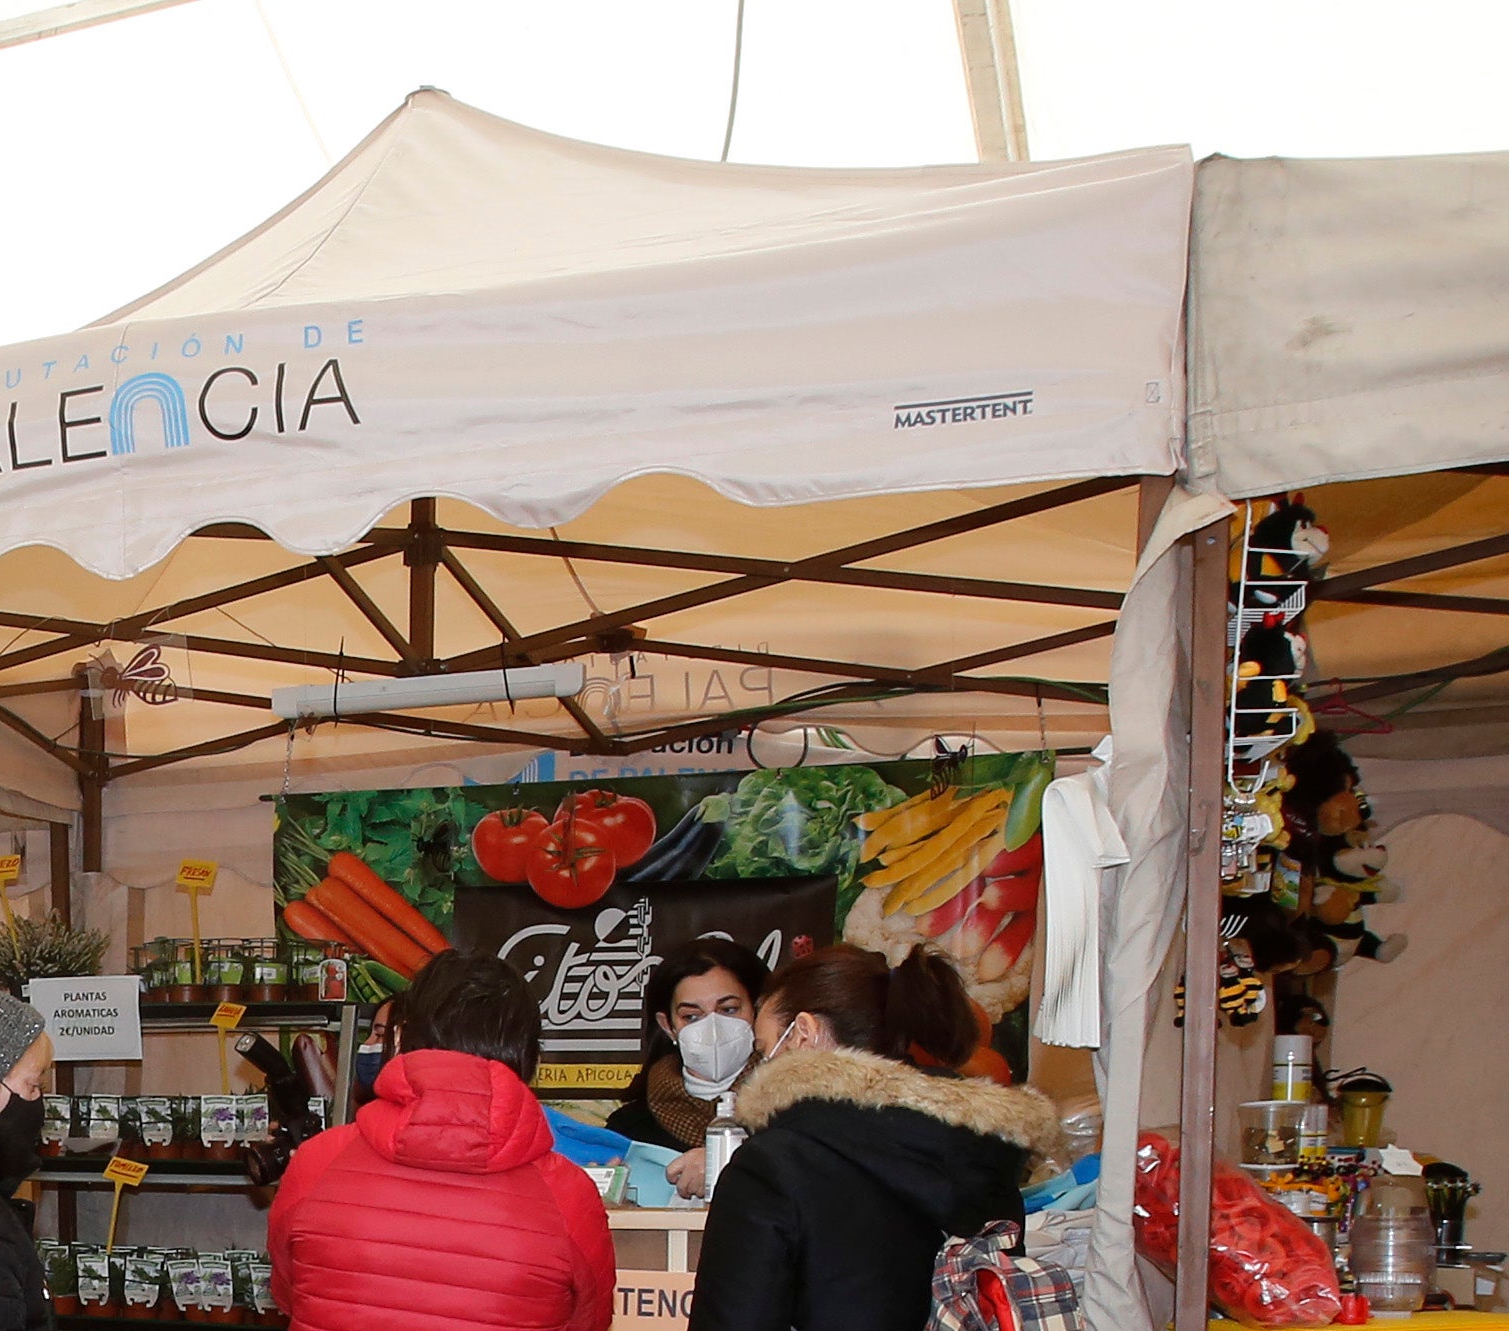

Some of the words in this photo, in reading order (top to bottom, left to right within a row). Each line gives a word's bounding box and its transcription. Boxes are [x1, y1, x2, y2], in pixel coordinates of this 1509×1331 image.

[303, 319, 364, 348] DE
[893, 400, 1032, 429] MASTERTENT
[63, 991, 107, 1002] PLANTAS
[53, 1007, 119, 1019] AROMATICAS
[59, 1025, 115, 1037] 2€/UNIDAD
[575, 1067, 633, 1082] APICOLA
